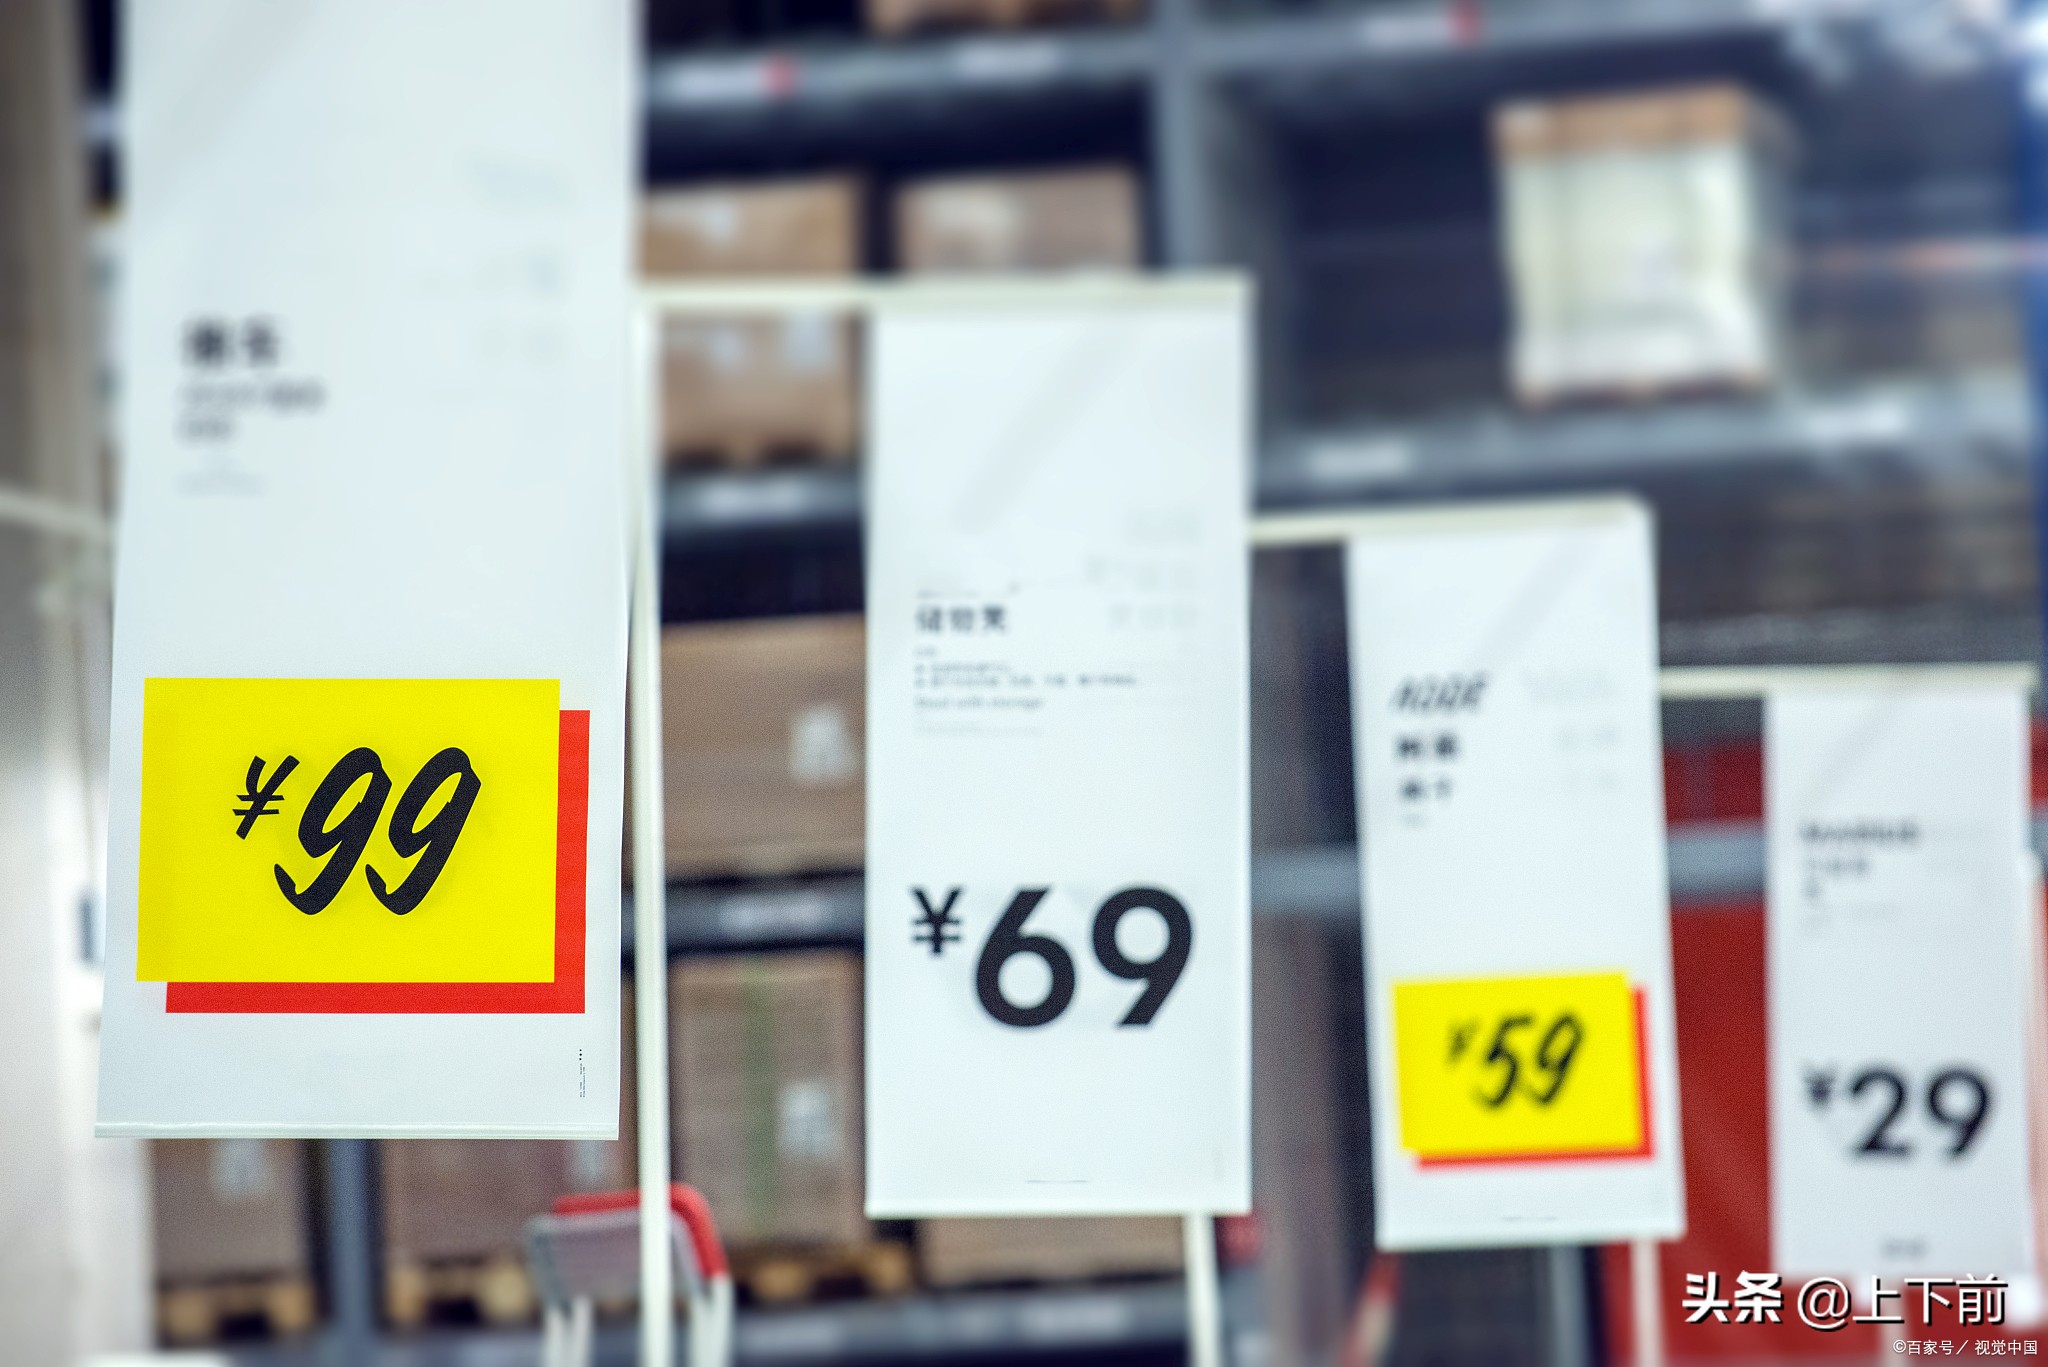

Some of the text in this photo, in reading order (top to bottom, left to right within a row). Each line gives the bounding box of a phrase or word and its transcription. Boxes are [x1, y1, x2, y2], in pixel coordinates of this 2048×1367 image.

[232, 746, 482, 916] ¥99
[911, 886, 1193, 1029] ¥69
[1804, 1064, 1993, 1159] ¥29
